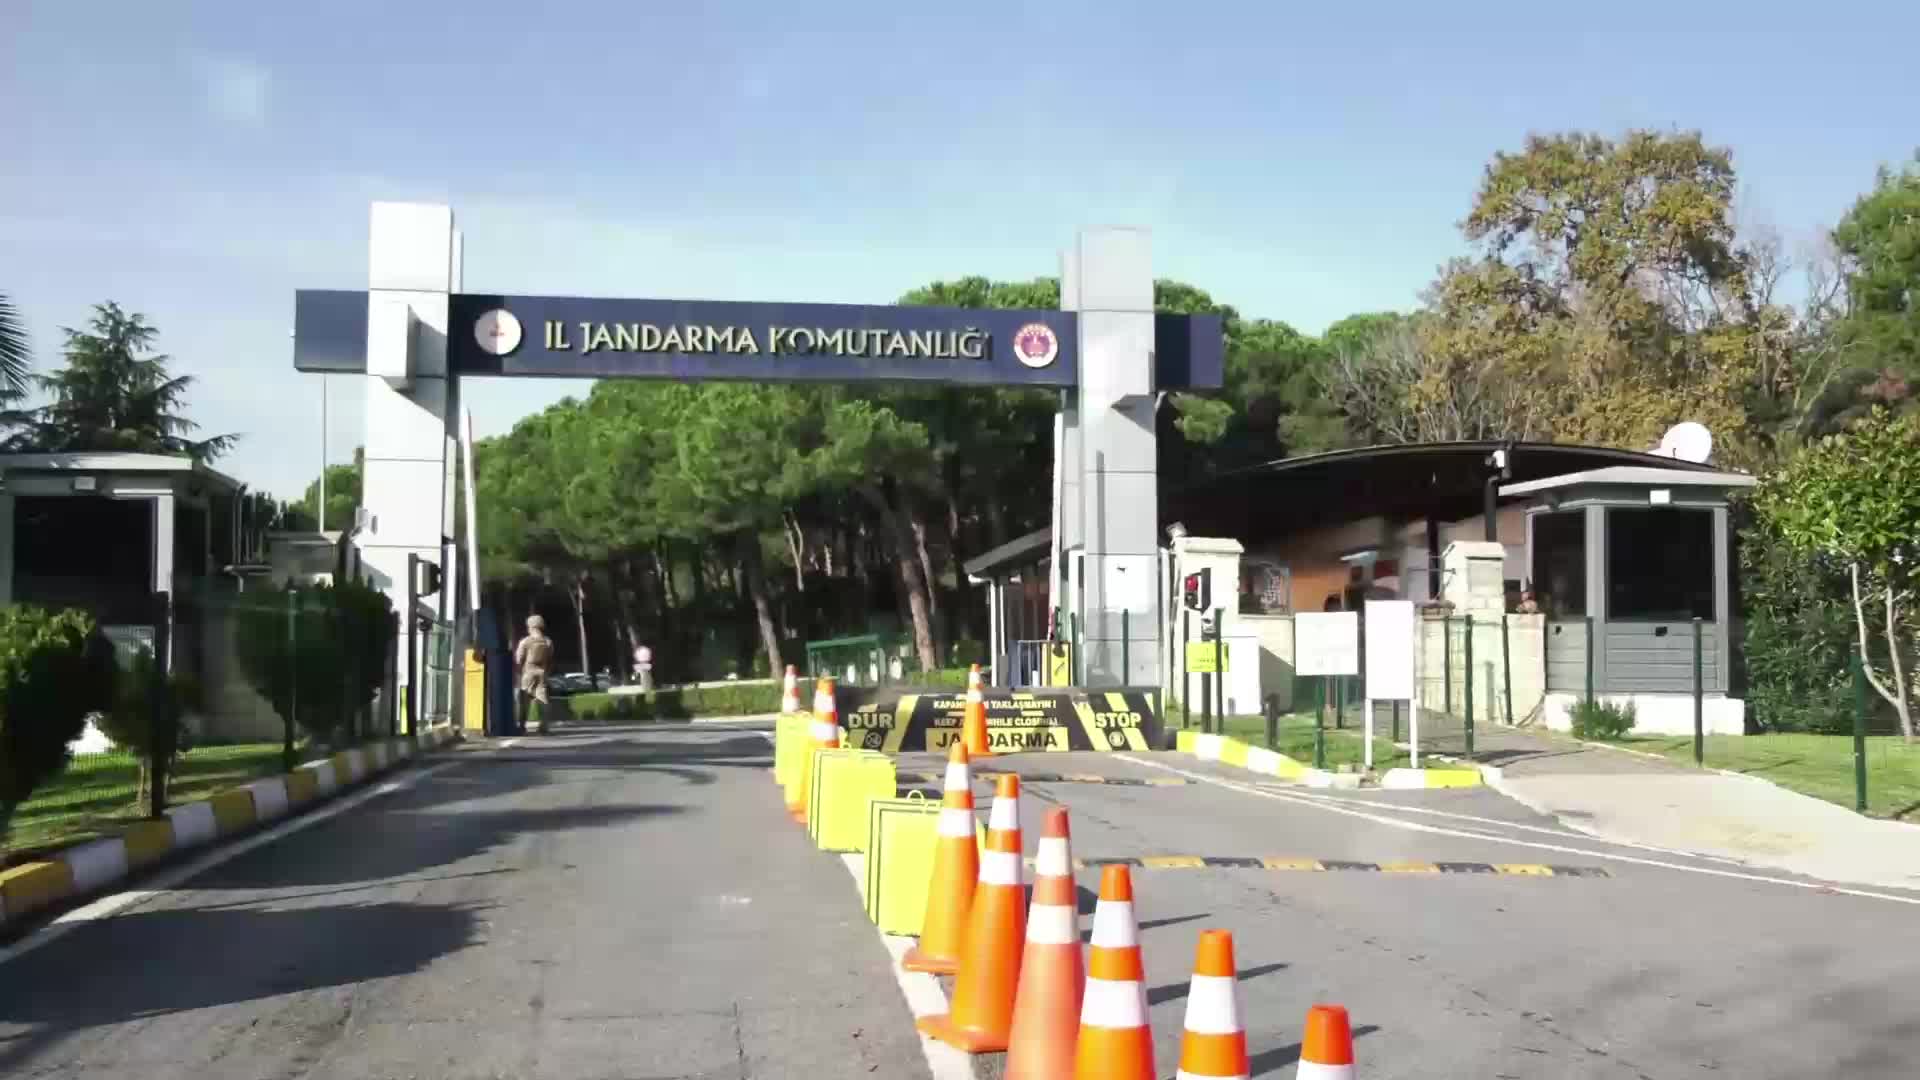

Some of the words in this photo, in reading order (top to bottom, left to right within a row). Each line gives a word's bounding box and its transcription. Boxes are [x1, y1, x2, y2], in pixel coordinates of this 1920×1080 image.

[579, 322, 759, 354] JANDARMA
[848, 713, 893, 729] DUR
[1095, 712, 1142, 729] STOP
